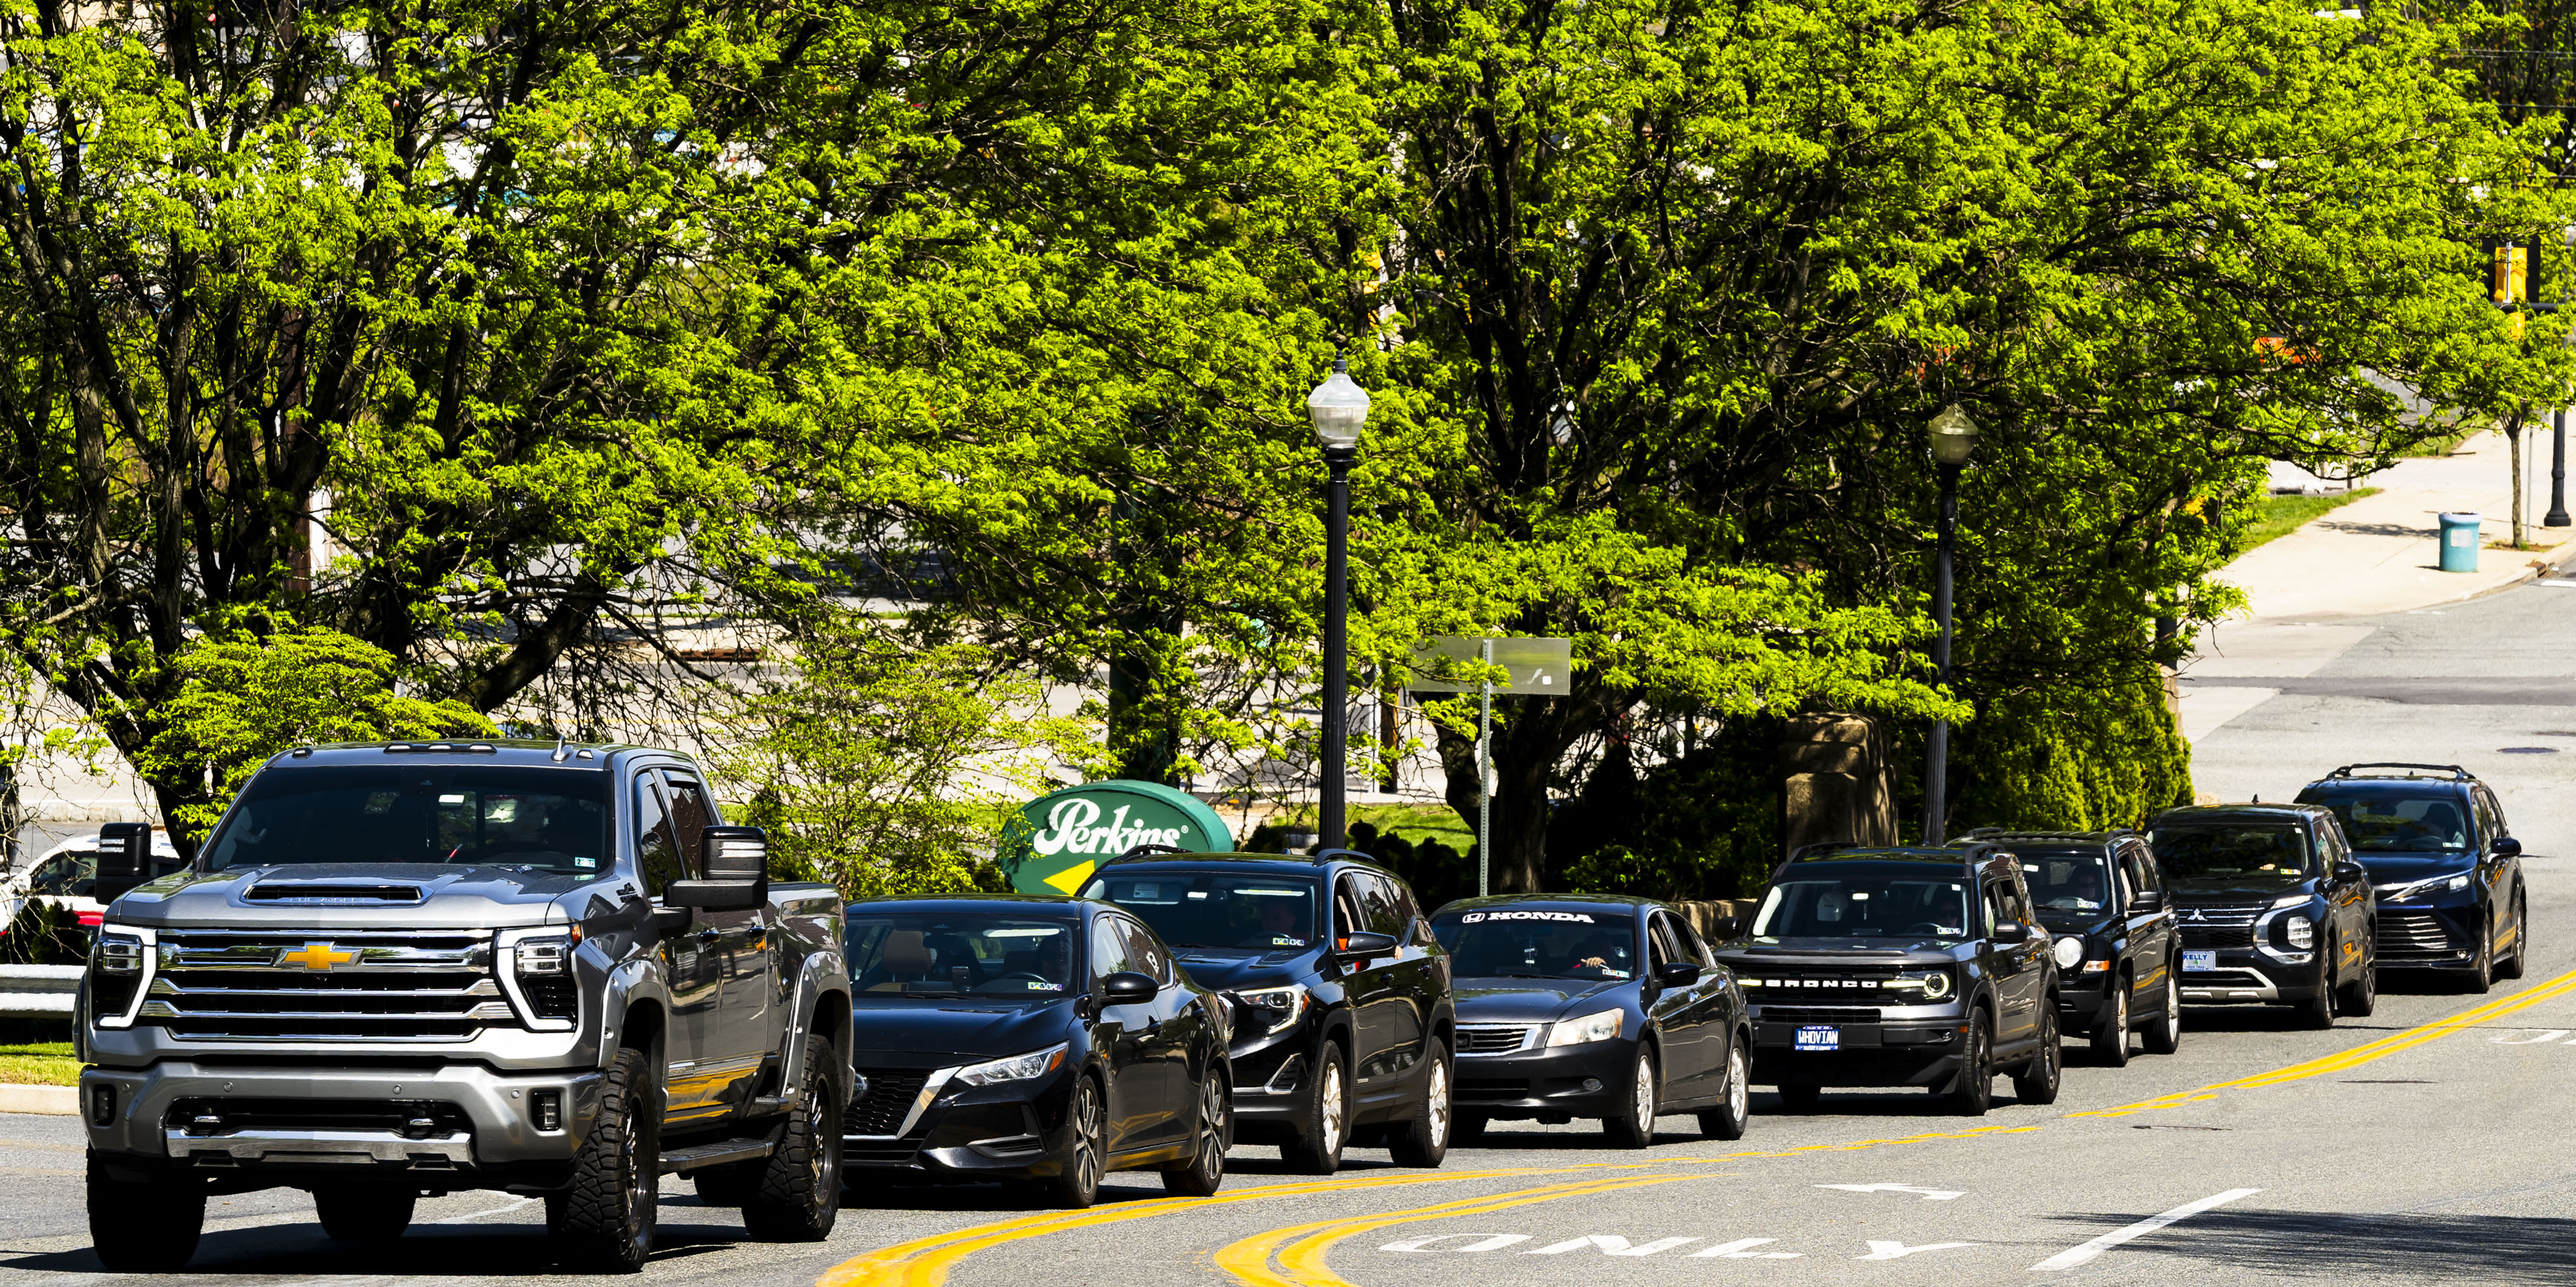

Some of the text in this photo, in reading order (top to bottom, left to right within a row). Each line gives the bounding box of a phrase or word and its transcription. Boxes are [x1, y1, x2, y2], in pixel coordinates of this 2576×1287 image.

[1033, 798, 1181, 855] Perkins
[1488, 912, 1595, 923] HONDA
[1766, 979, 1877, 988] BRONCO
[1798, 1030, 1839, 1045] WHOVIAN
[1378, 1233, 1983, 1261] ONLY
